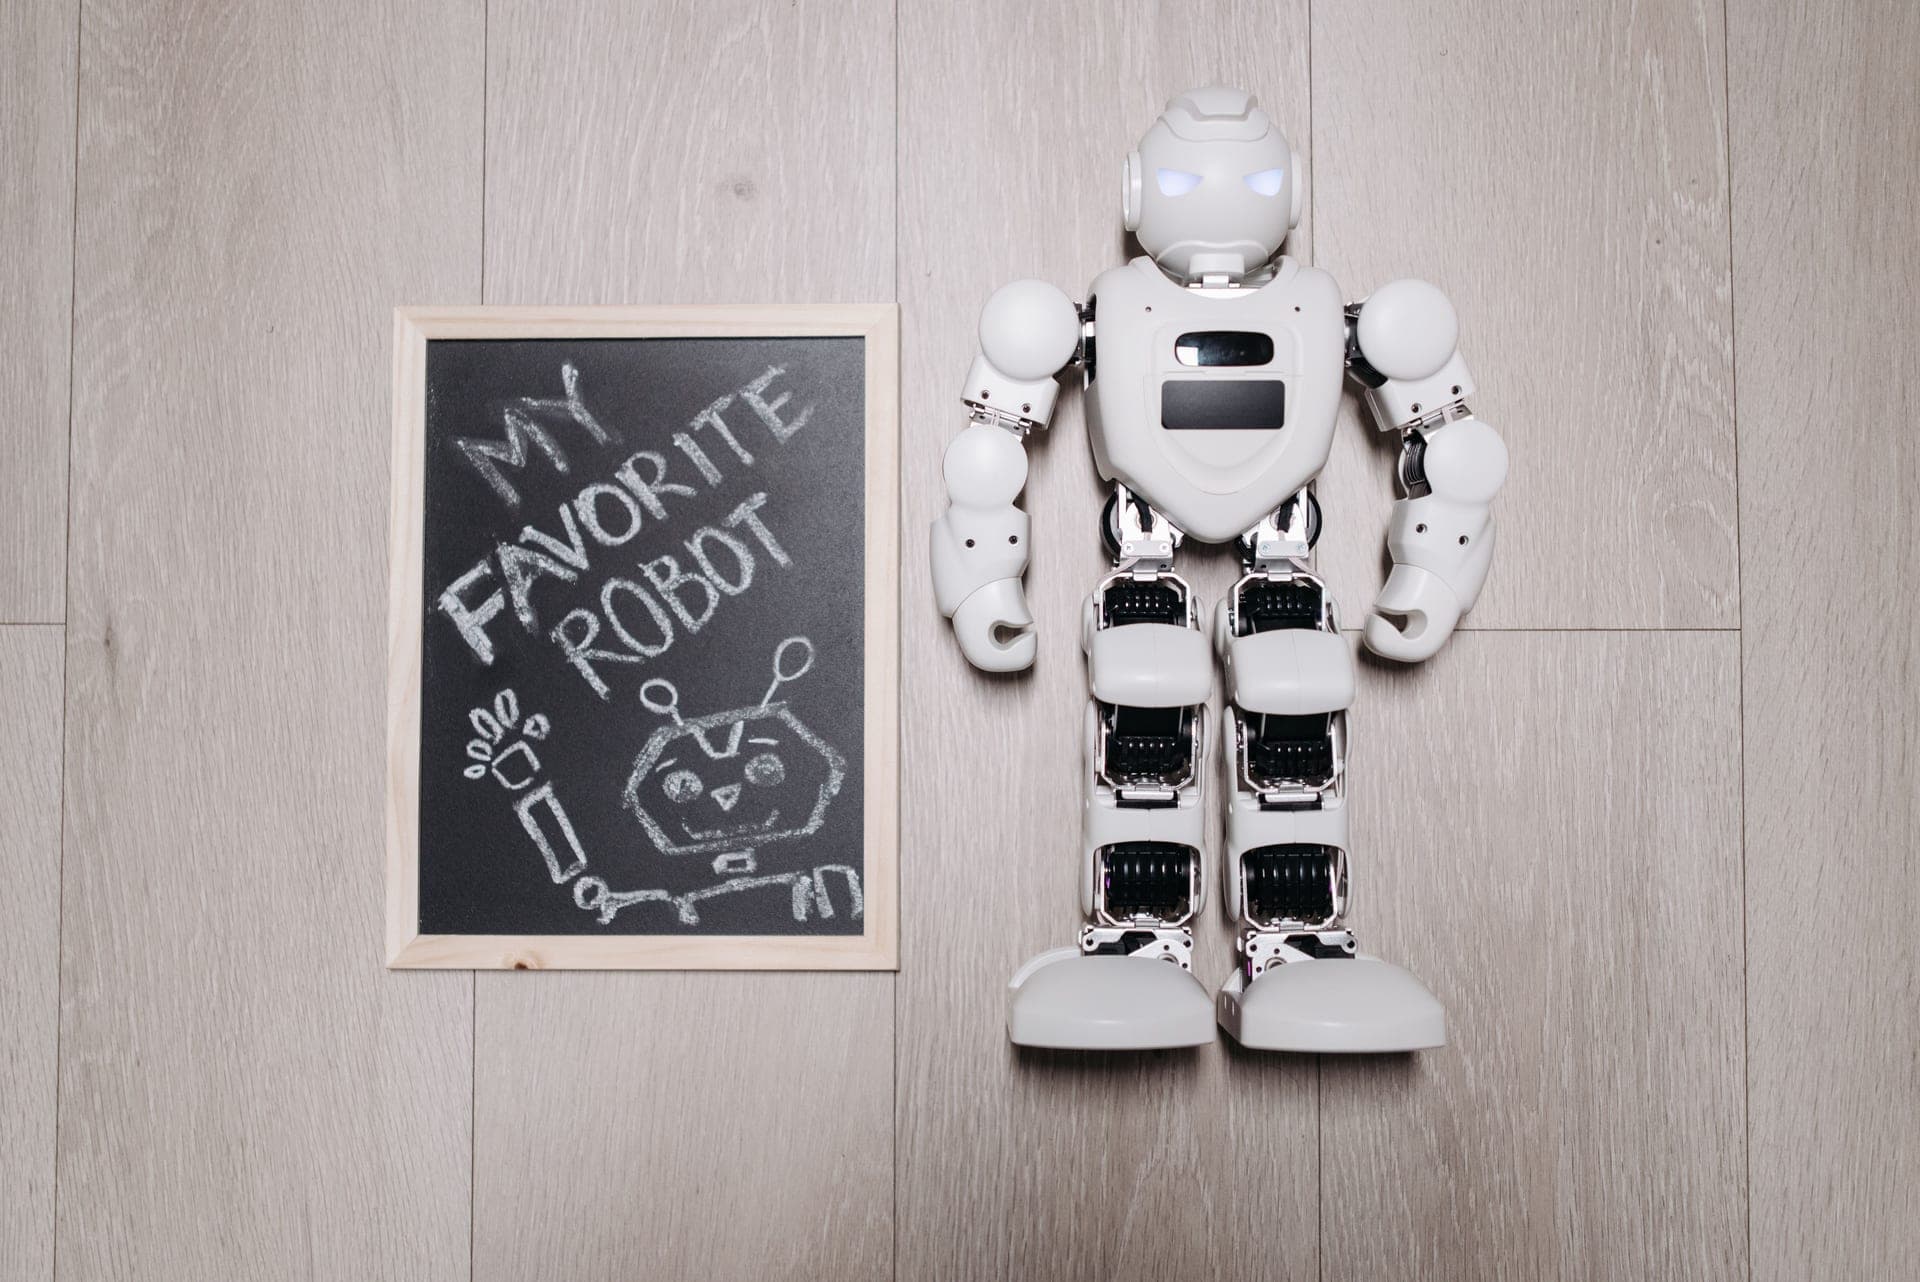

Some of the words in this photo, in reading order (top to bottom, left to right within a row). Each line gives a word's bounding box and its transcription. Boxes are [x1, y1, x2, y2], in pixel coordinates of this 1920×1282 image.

[438, 364, 814, 665] FAVORITE
[456, 363, 620, 505] MY
[551, 492, 793, 700] ROBOT
